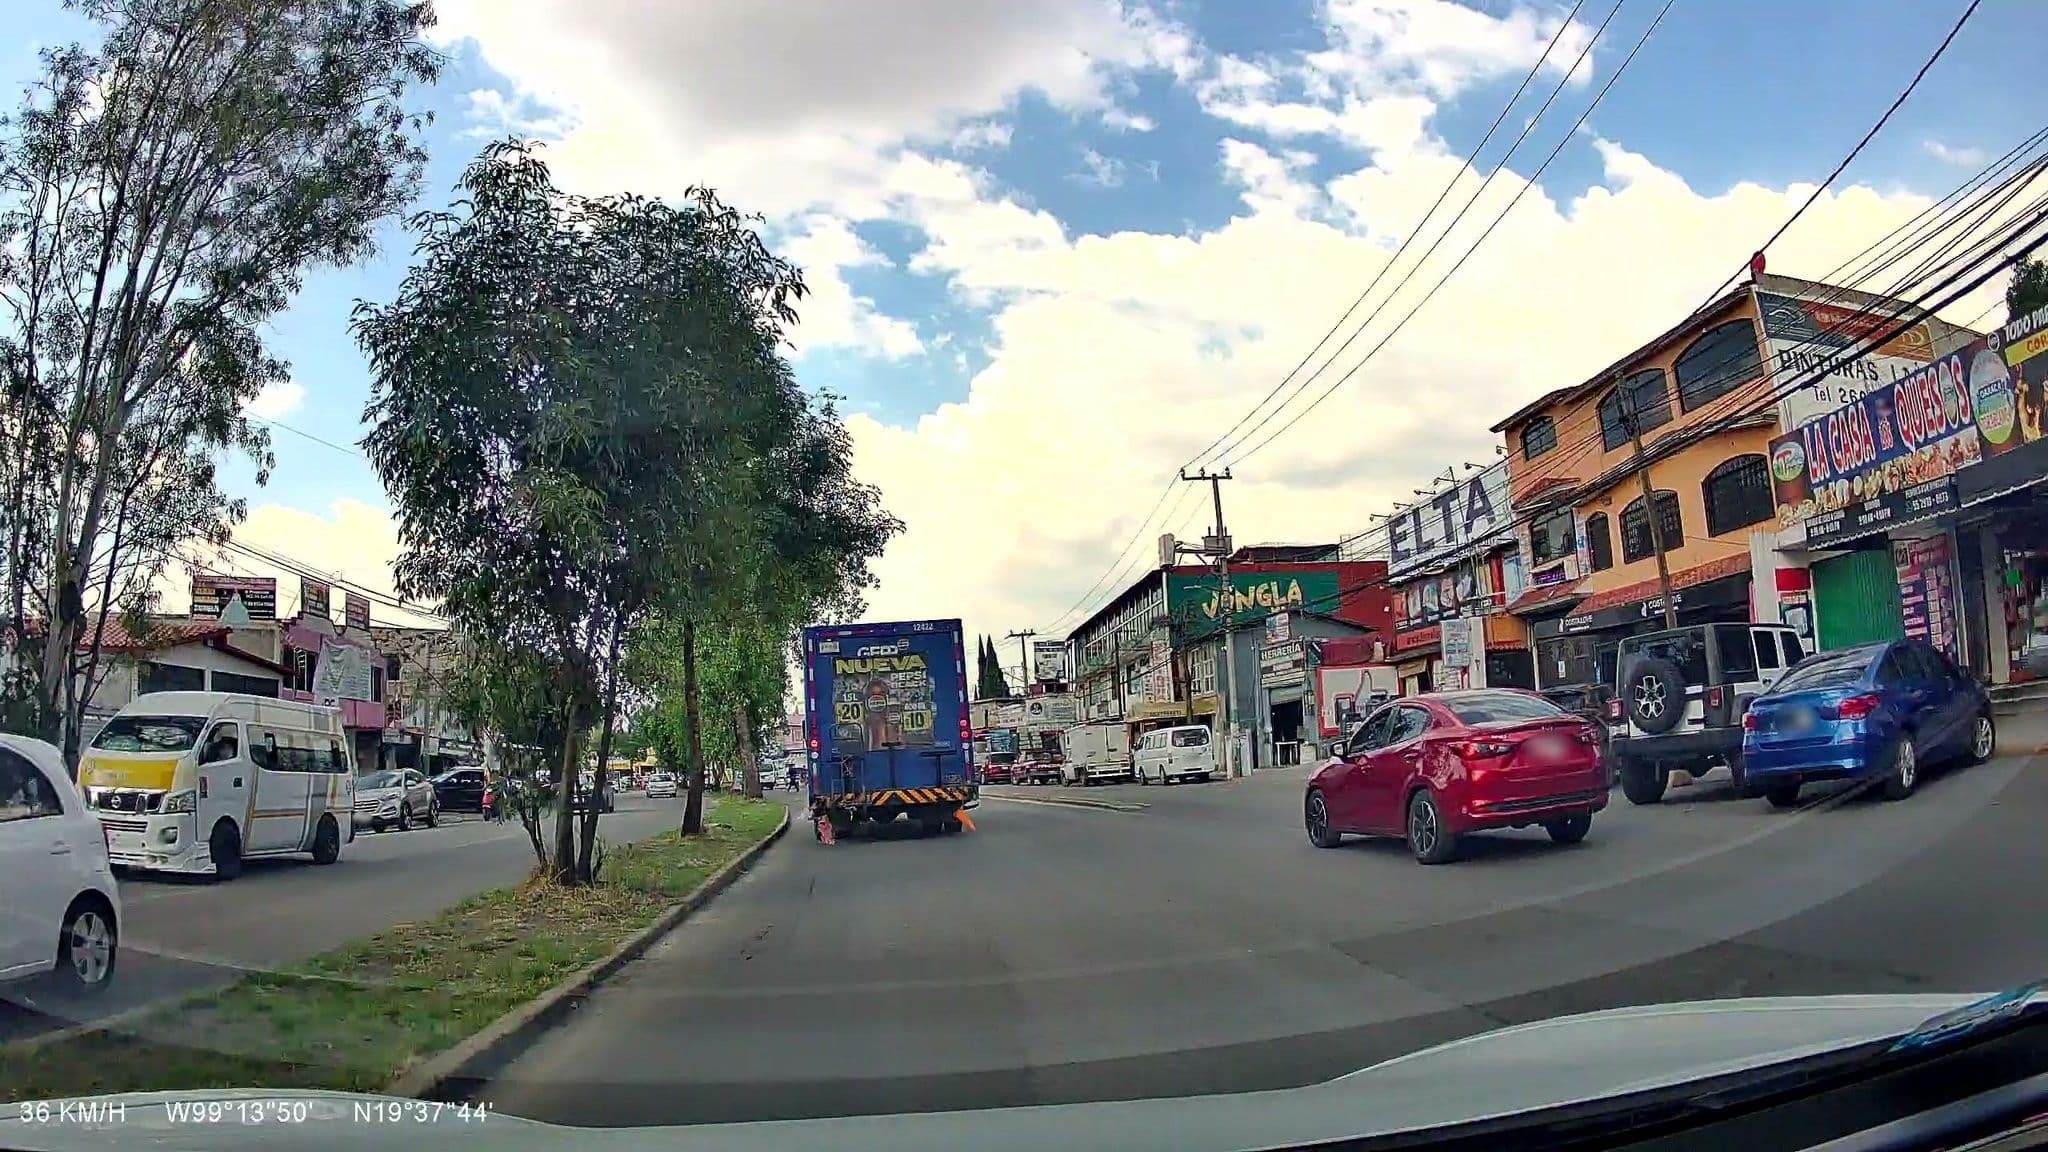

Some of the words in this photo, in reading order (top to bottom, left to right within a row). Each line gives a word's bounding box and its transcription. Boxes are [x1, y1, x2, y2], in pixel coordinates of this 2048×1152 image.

[2004, 314, 2030, 342] TODO
[1803, 421, 1830, 484] LA
[1828, 401, 1877, 475] CASA
[1893, 354, 1972, 453] QUESOS
[835, 654, 929, 675] NUEVA
[890, 671, 927, 681] PEPSI
